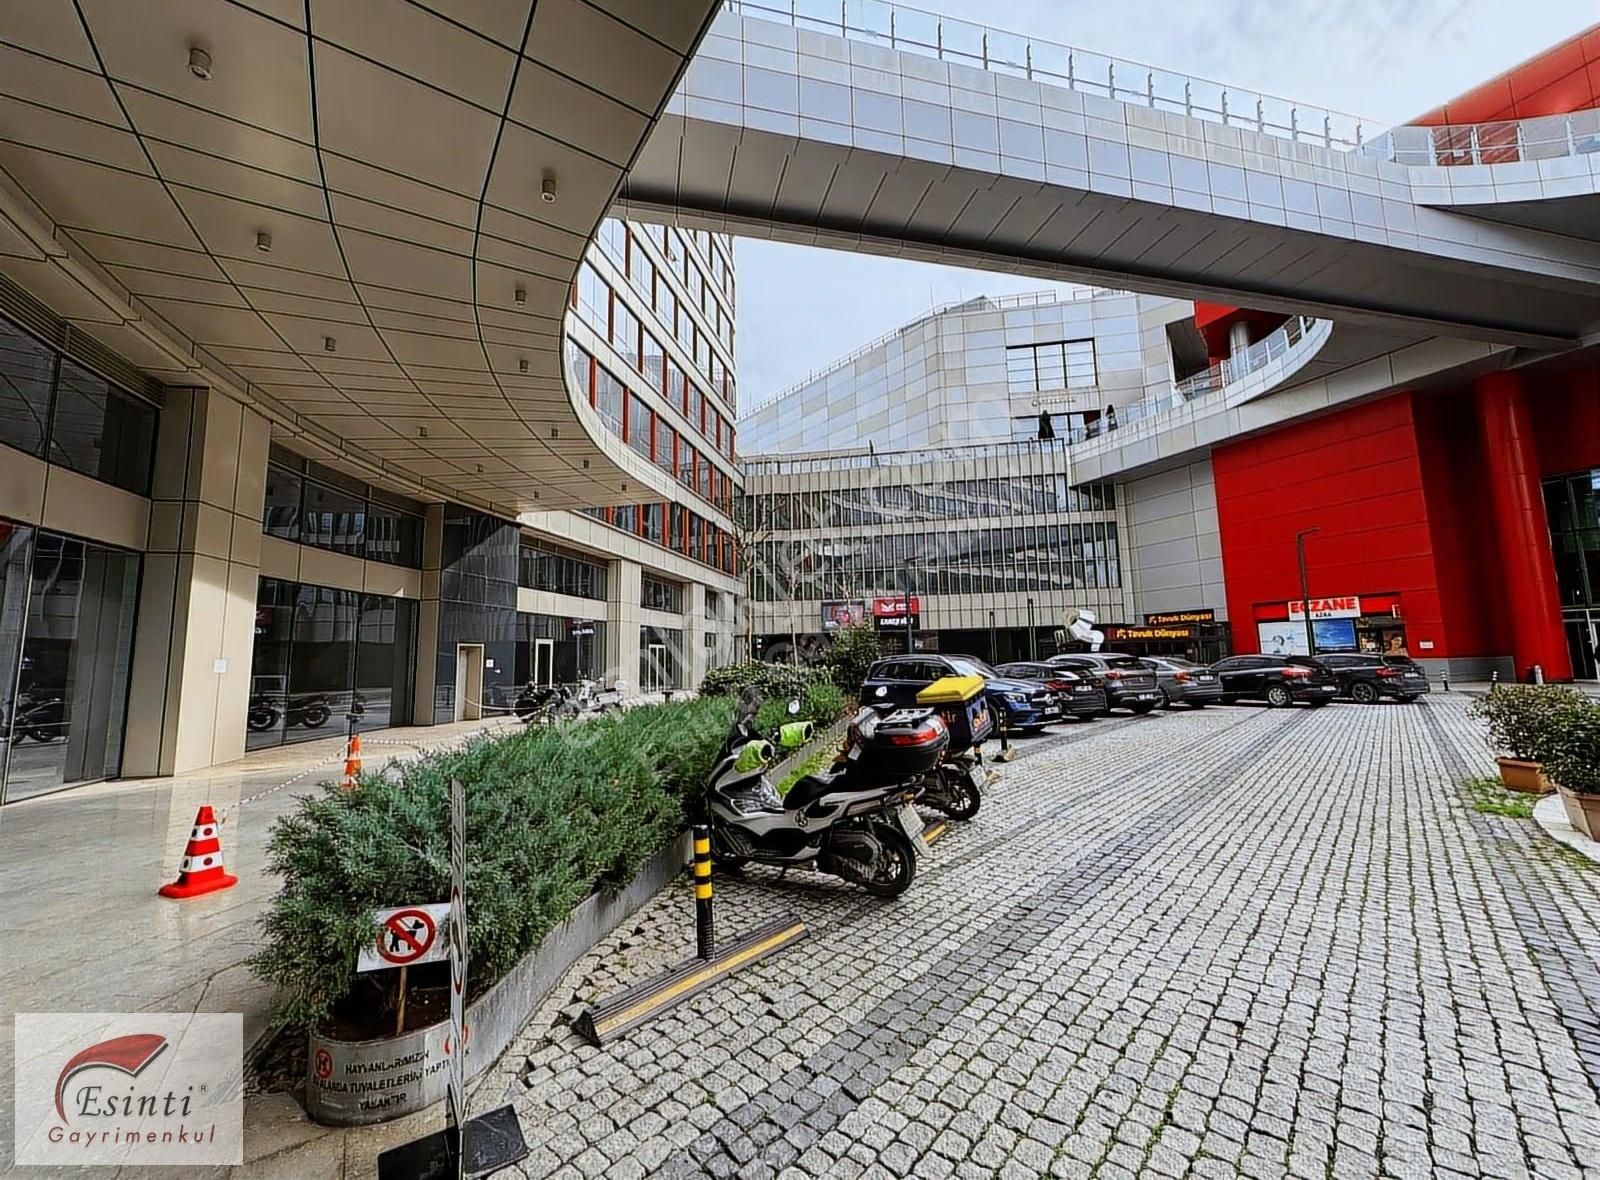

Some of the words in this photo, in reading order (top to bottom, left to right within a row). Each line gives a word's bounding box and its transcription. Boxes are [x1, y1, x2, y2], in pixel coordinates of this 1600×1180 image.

[1291, 598, 1357, 614] ECZANE
[1158, 615, 1179, 623] Tavuk
[1128, 630, 1153, 638] Tavuk
[1154, 628, 1188, 638] Dünyası
